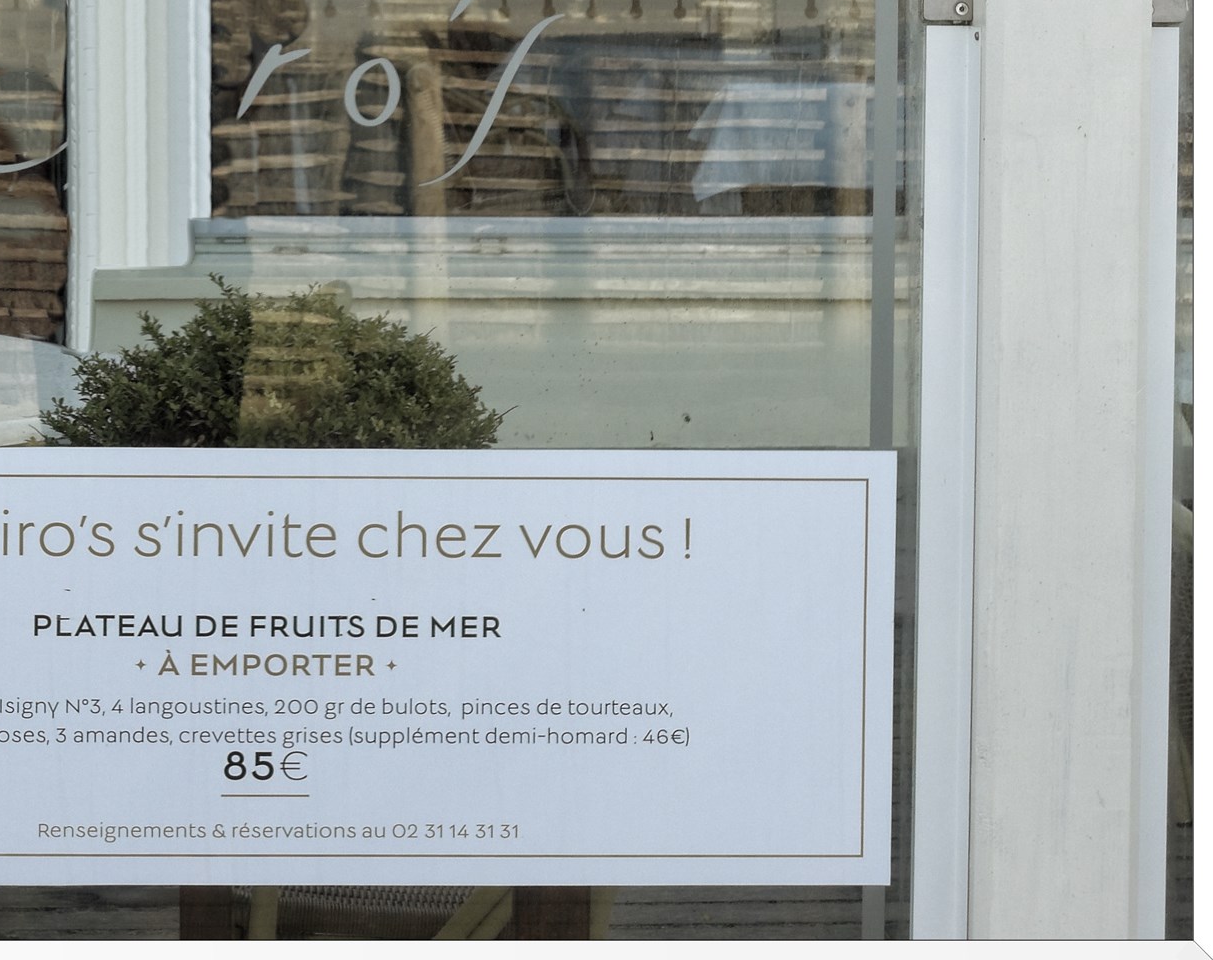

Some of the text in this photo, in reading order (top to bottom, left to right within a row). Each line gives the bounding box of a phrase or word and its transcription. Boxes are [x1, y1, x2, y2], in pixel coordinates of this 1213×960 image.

[133, 509, 337, 560] s'invite
[357, 510, 503, 560] chez
[518, 524, 665, 560] vous
[683, 517, 692, 560] !
[33, 614, 502, 639] PLATEAU DE FRUITS DE MER
[157, 649, 376, 677] À EMPORTER
[65, 699, 106, 717] N°3,
[110, 699, 124, 715] 4
[130, 697, 269, 720] langoustines,
[273, 699, 319, 715] 200
[323, 701, 345, 720] gr
[350, 698, 376, 715] de
[381, 698, 452, 718] bulots,
[461, 698, 531, 720] pinces
[536, 699, 562, 716] de
[567, 700, 674, 718] tourteaux,
[55, 728, 67, 744] 3
[73, 726, 174, 746] amandes,
[178, 728, 277, 744] crevettes
[282, 727, 344, 748] grises
[348, 726, 481, 749] (supplément
[484, 727, 628, 745] demi-homard
[642, 727, 691, 747] 46€)
[223, 751, 309, 781] 85€
[38, 822, 520, 843] Renseignements & réservations au 02 31 14 31 31
